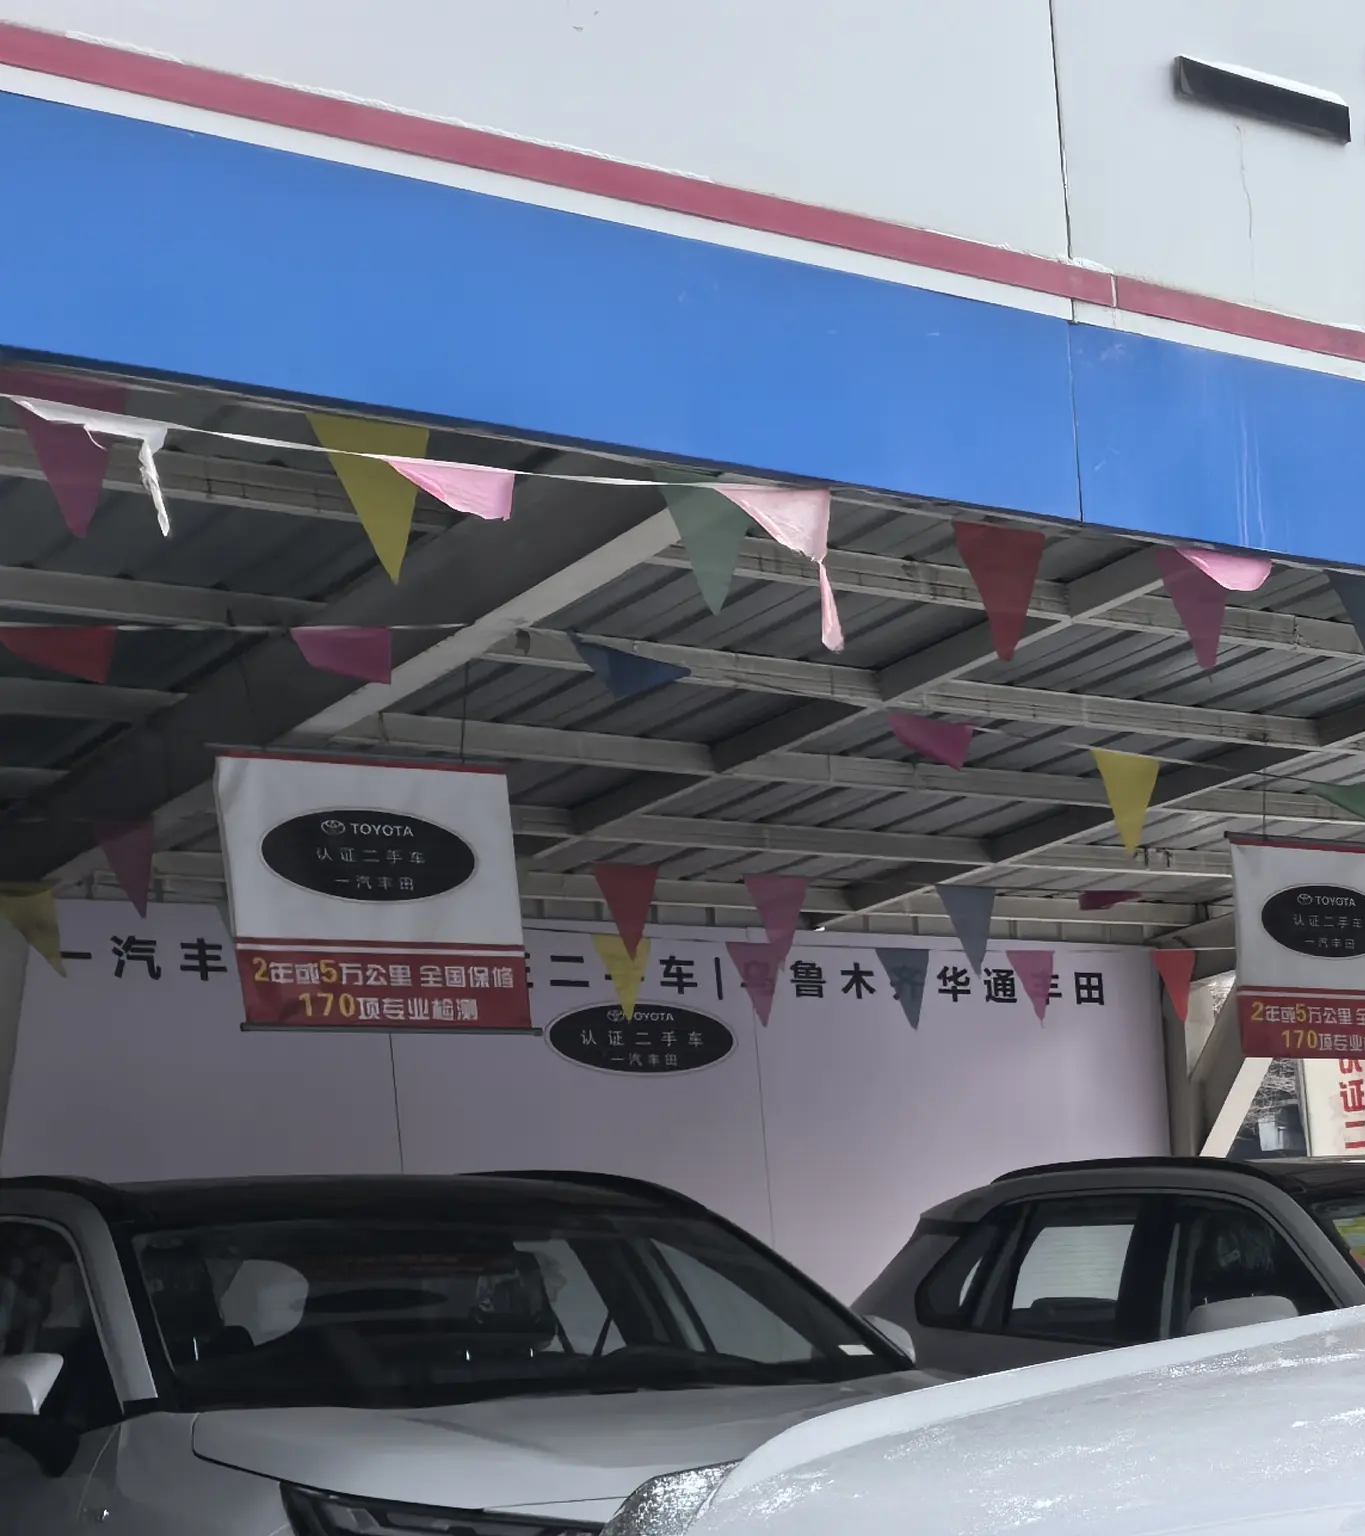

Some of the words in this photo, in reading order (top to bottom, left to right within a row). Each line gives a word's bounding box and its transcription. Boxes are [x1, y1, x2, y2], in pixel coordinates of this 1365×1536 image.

[350, 822, 414, 837] TOYOTA
[316, 847, 426, 865] 认证二手车
[335, 876, 415, 891] 一汽丰田
[1316, 894, 1356, 908] TOYOTA
[252, 957, 412, 988] 2年或5万公里
[420, 965, 514, 989] 全国保修
[299, 992, 479, 1021] 170项专业检测
[1251, 1002, 1353, 1026] 2年或5万公里
[630, 1010, 675, 1022] OYOTA
[580, 1030, 703, 1048] 认证二手车
[611, 1053, 678, 1067] 一汽丰田
